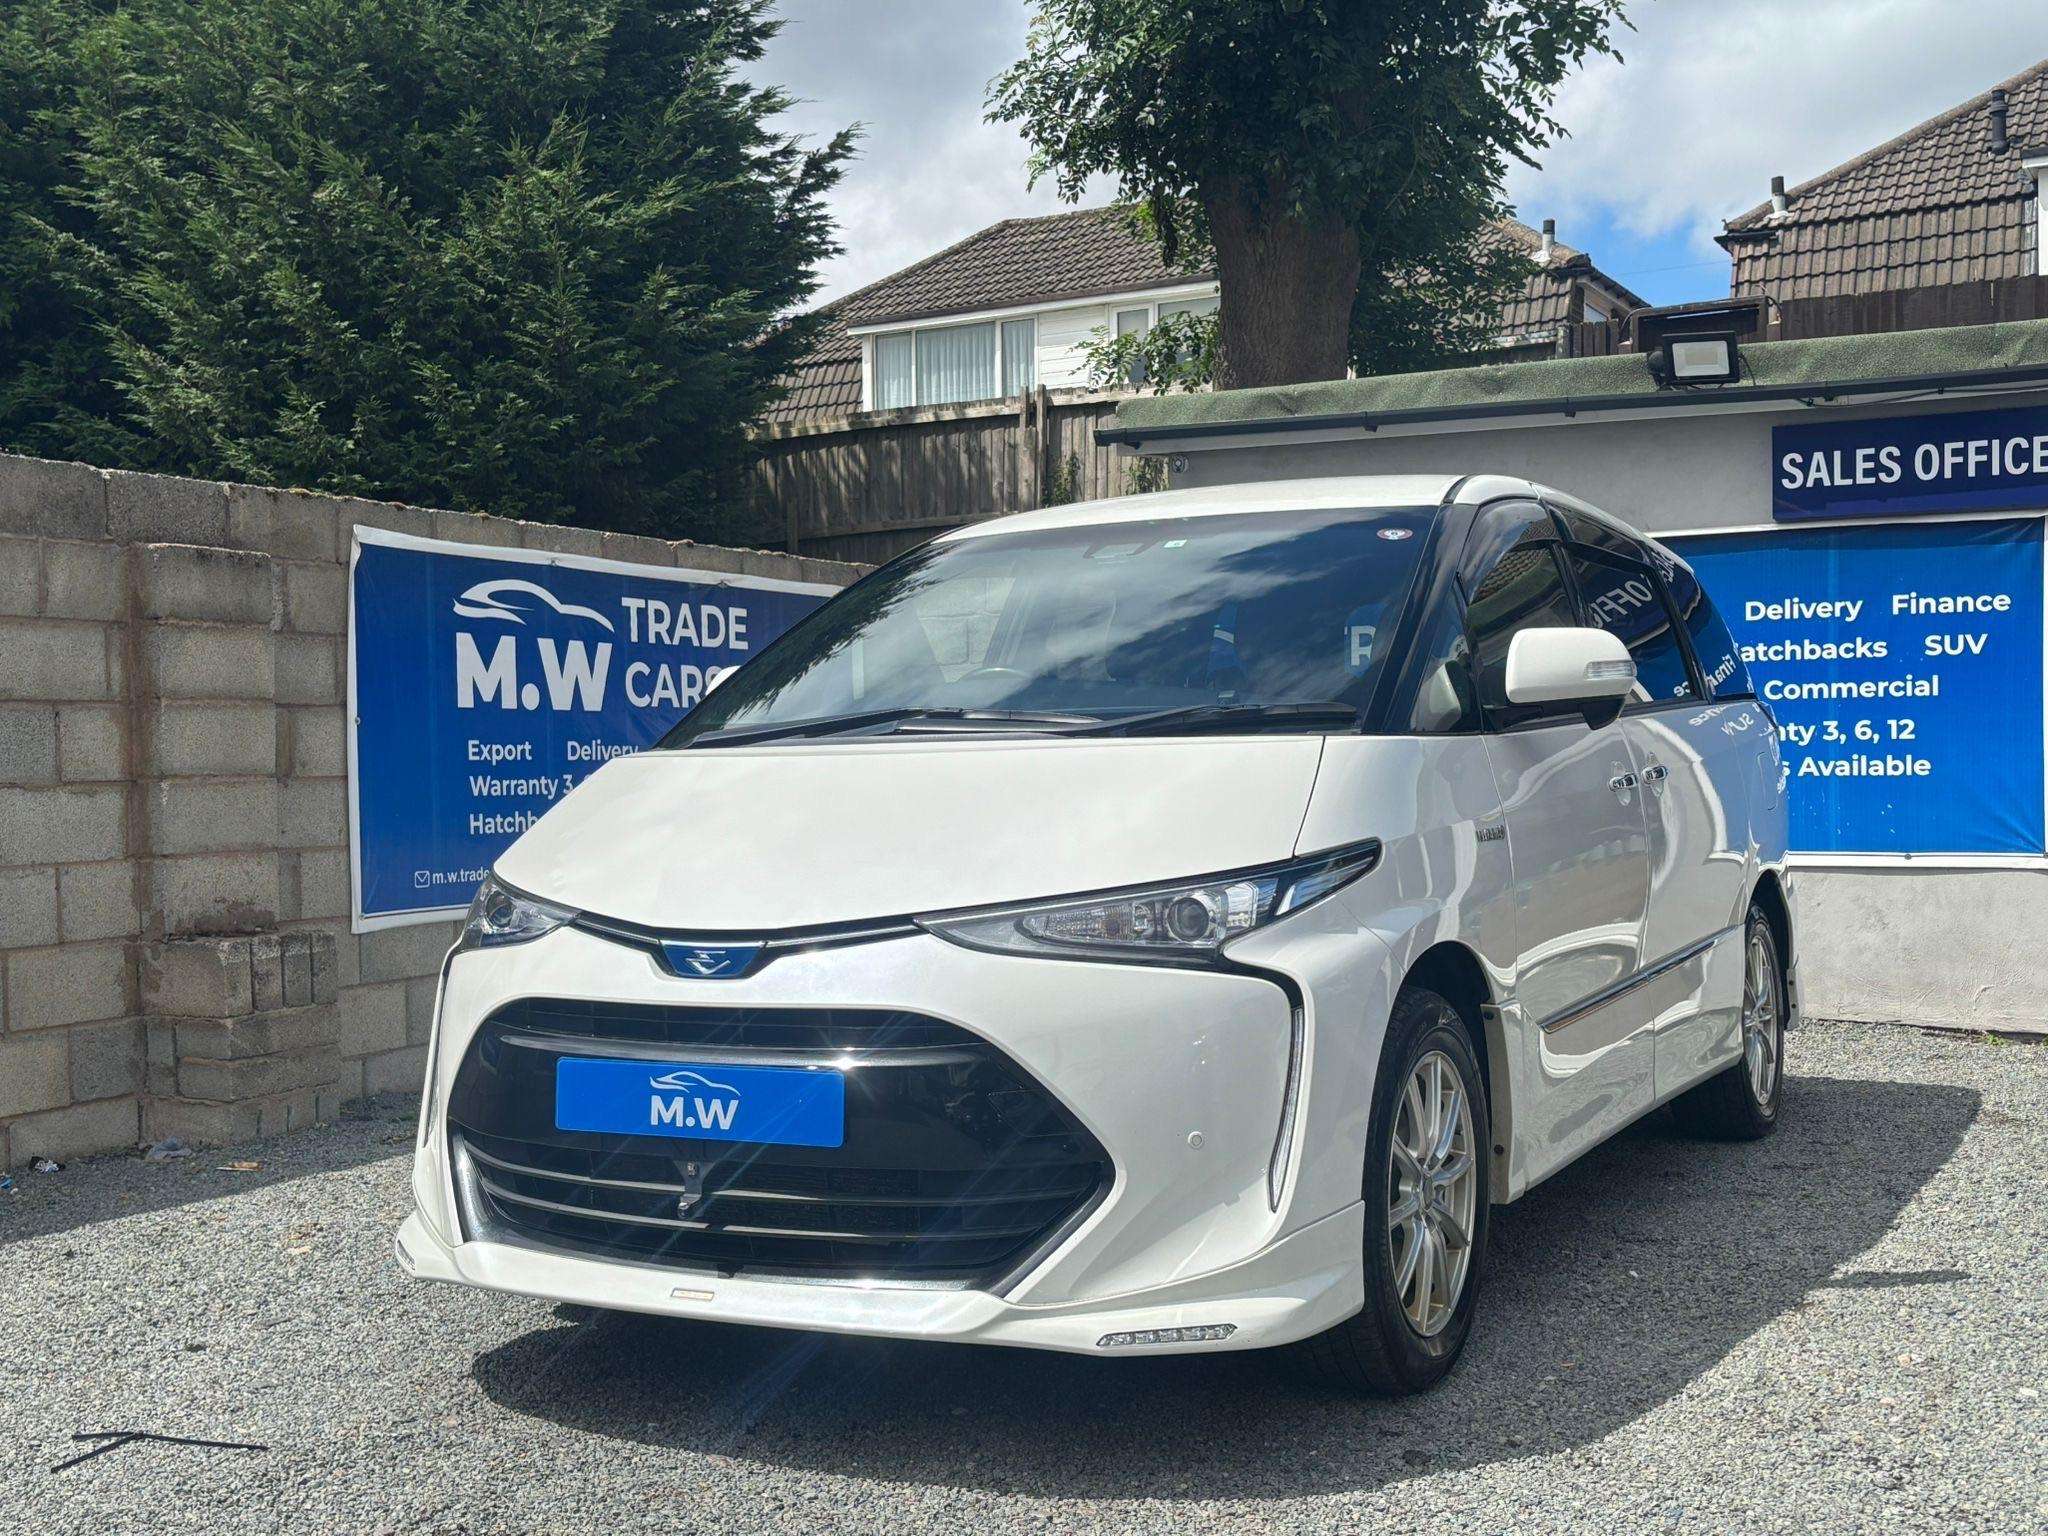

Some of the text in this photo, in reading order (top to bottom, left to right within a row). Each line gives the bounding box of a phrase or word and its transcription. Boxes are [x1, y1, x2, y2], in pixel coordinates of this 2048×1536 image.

[1781, 436, 2048, 490] SALES OFFICE
[1745, 592, 2012, 622] Delivery Finance
[621, 597, 749, 650] TRADE
[1925, 633, 1988, 656] SUV
[456, 632, 613, 712] M.W
[1764, 674, 1939, 700] Commercial
[1822, 720, 1847, 744] 3,
[1854, 719, 1880, 744] 6,
[1887, 718, 1916, 741] 12
[468, 739, 532, 766] Export
[1797, 754, 1932, 777] Available
[469, 774, 559, 800] Warranty
[649, 1095, 739, 1130] M.W
